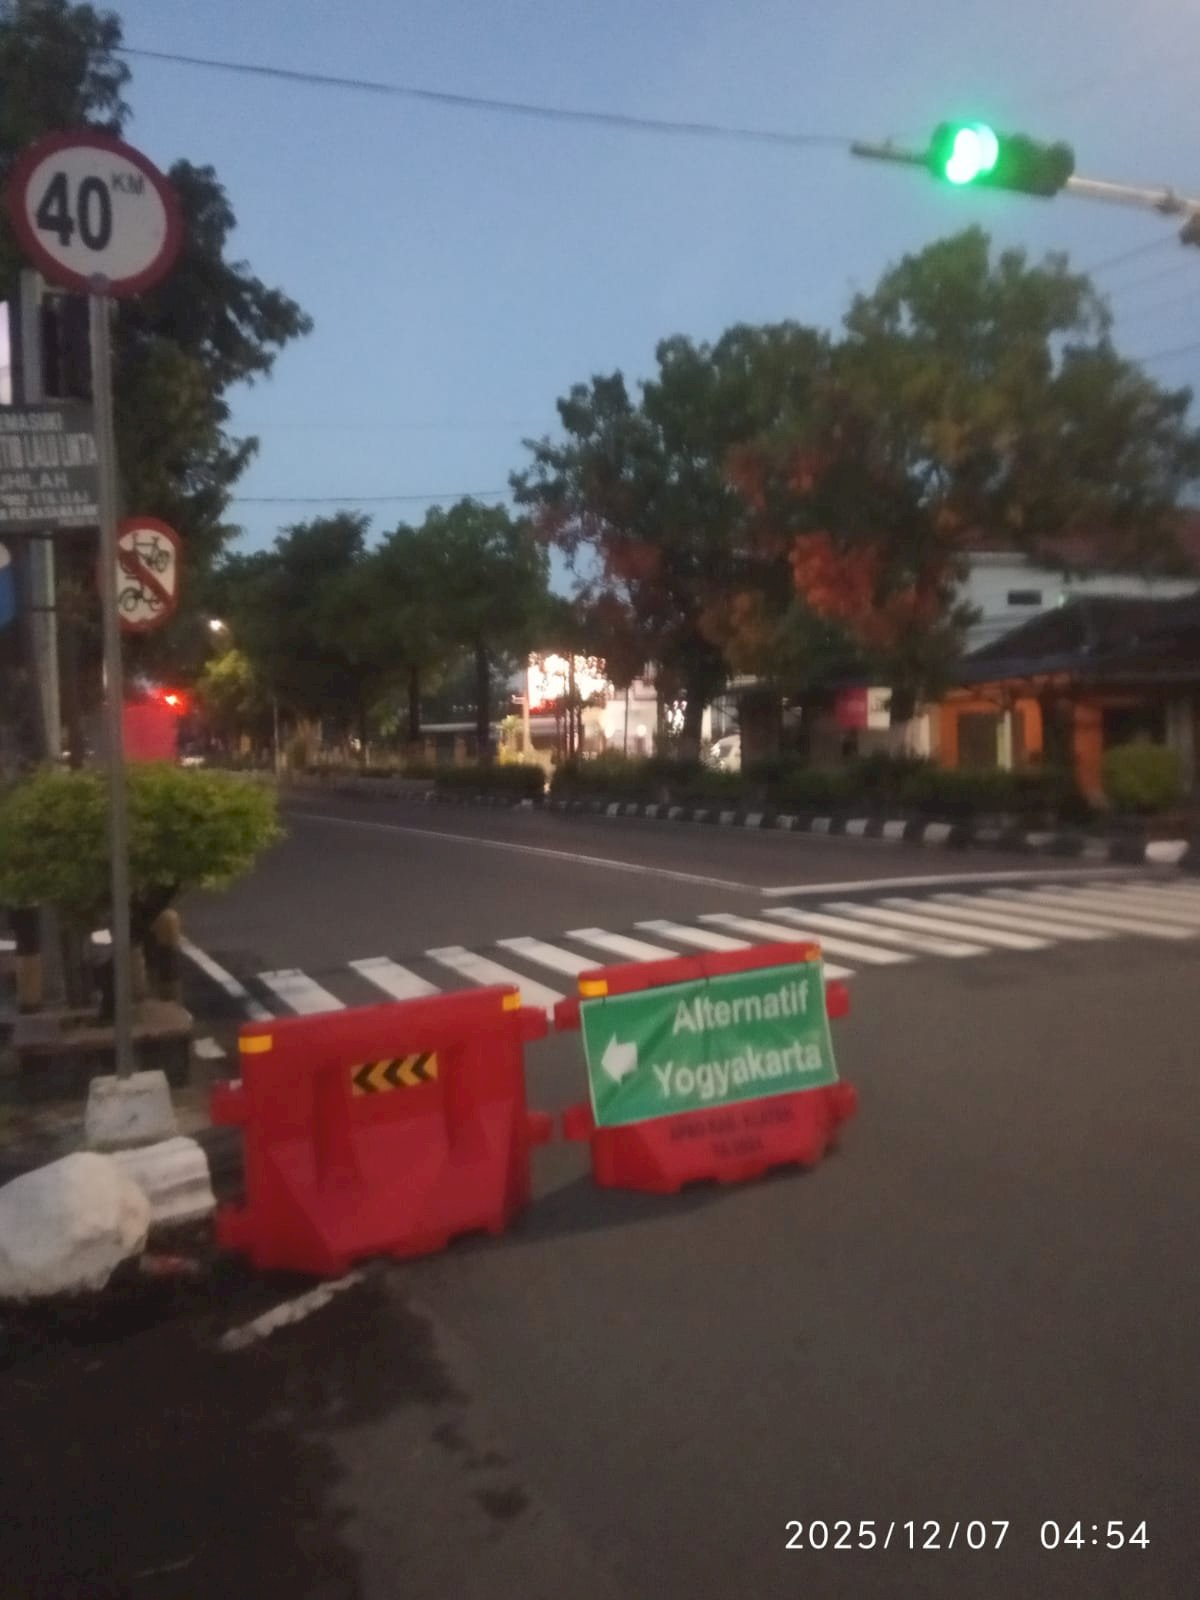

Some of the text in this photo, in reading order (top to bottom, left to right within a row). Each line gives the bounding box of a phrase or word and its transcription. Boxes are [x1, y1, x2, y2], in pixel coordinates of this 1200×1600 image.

[37, 171, 145, 251] 40 KM
[672, 979, 809, 1035] Alternatif
[653, 1041, 822, 1099] Yogyakarta
